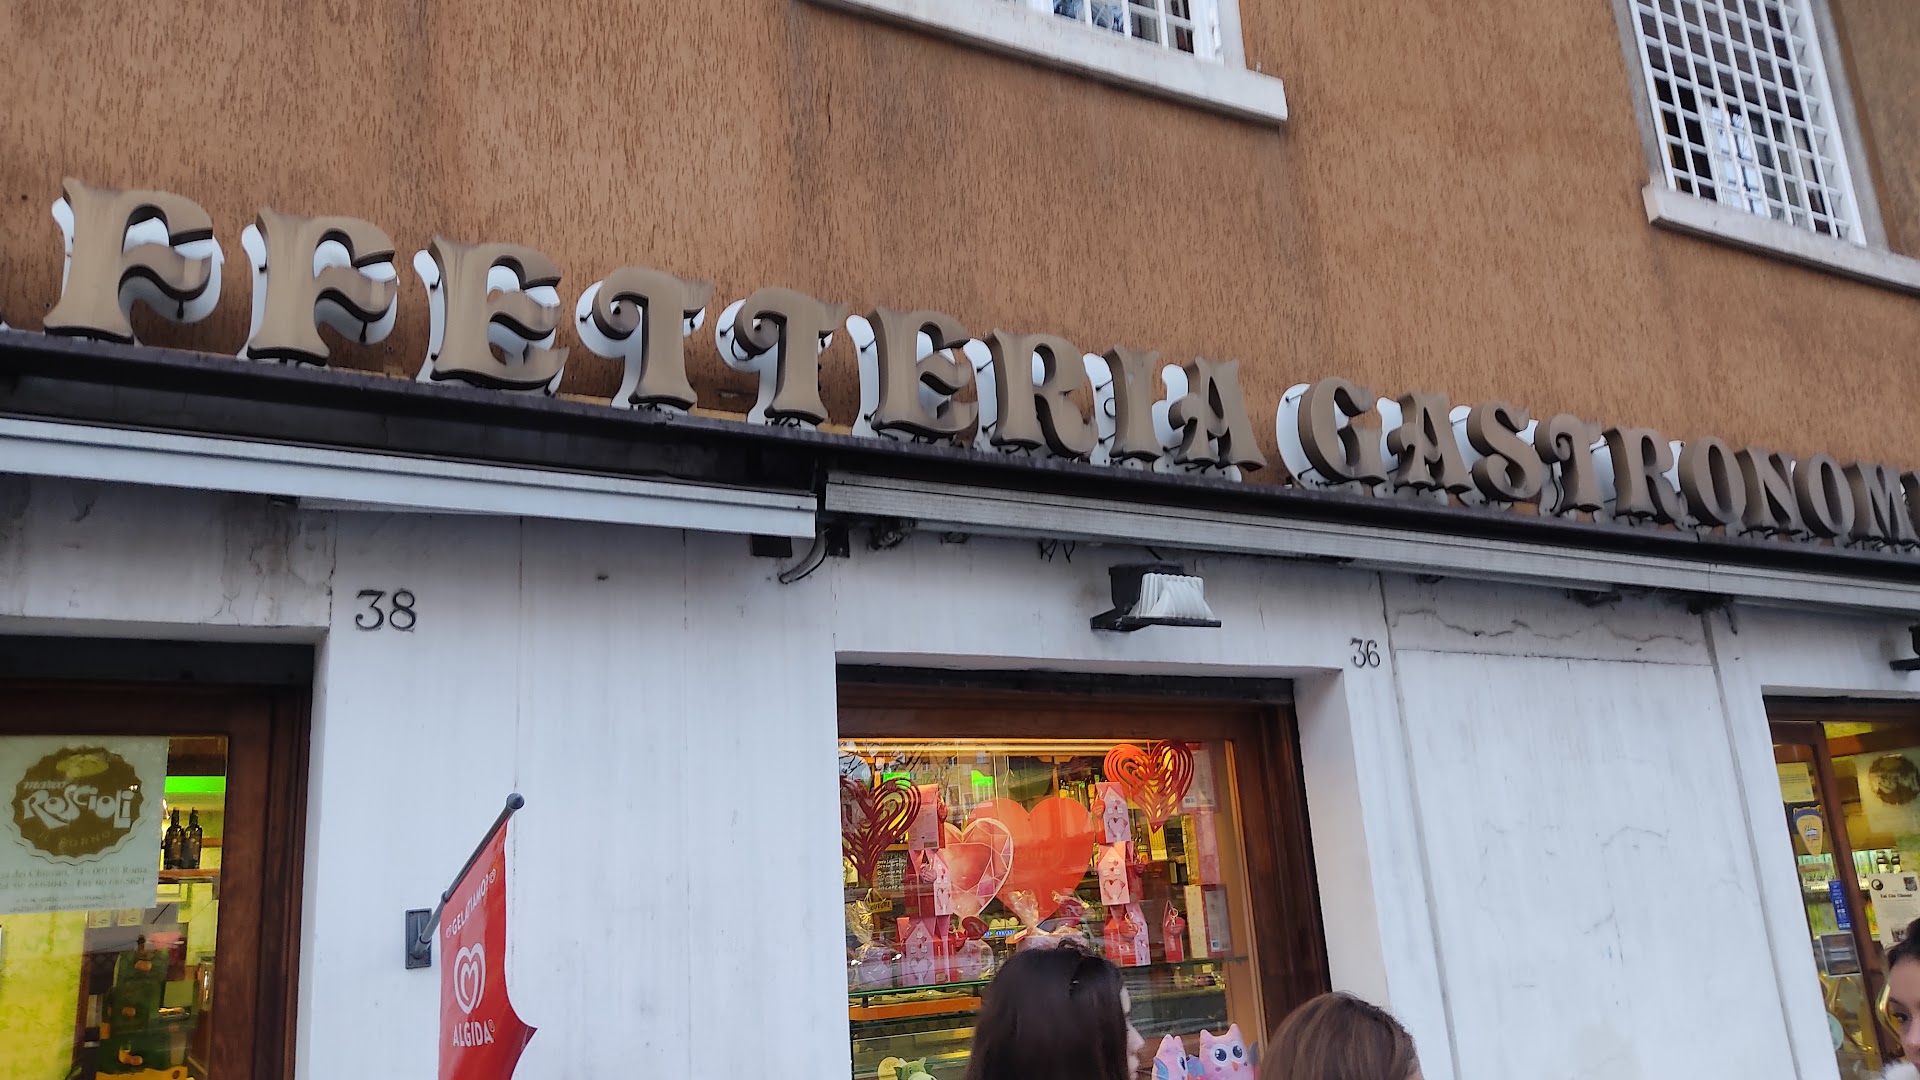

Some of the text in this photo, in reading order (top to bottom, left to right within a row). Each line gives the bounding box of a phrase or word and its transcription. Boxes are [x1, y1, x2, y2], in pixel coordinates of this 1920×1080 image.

[1299, 376, 1920, 543] GASTRONOM
[355, 589, 416, 631] 38
[1350, 638, 1380, 668] 36
[452, 1020, 495, 1047] ALGIDA
